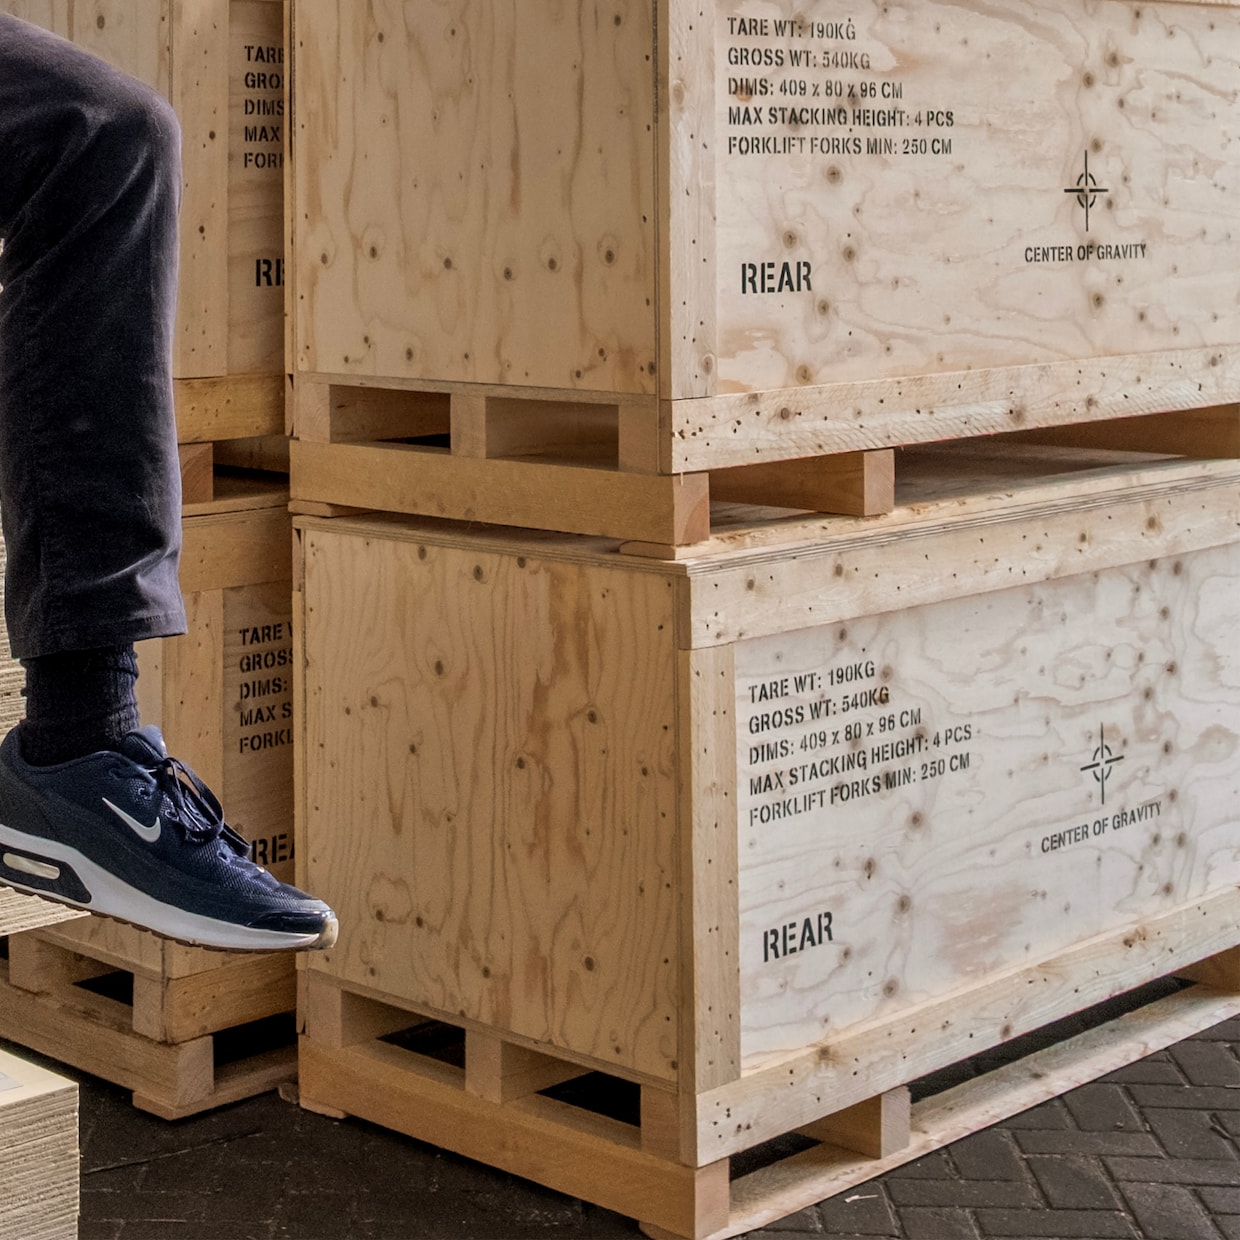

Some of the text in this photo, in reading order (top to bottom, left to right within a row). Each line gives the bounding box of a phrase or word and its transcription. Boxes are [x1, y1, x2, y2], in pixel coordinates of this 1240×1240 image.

[728, 17, 856, 40] TARE WT: 190KG
[728, 47, 870, 70] GROSS WT: 540KG
[245, 72, 284, 89] GRO
[728, 78, 774, 96] DIMS:
[780, 79, 807, 96] 409
[825, 80, 842, 97] 80
[860, 82, 876, 98] 96
[882, 82, 902, 98] CM
[729, 107, 954, 127] MAX STACKING HEIGHT: 4 PCS
[245, 126, 280, 142] MAX
[728, 137, 952, 155] FORKLIFT FORKS MIN: 250 CM
[1025, 244, 1147, 262] CENTER OF GRAVITY
[741, 261, 812, 294] REAR
[239, 623, 282, 645] TARE
[240, 677, 287, 699] DIMS:
[749, 660, 875, 704] TARE WT: 190KG
[240, 705, 276, 726] MAX
[749, 686, 889, 734] GROSS WT: 540KG
[750, 740, 794, 765] DIMS:
[800, 730, 826, 753] 409
[844, 722, 861, 741] 80
[879, 714, 896, 733] 96
[900, 708, 921, 728] CM
[750, 724, 972, 796] MAX STACKING HEIGHT: 4 PCS
[750, 752, 970, 827] FORKLIFT FORKS MIN: 250 CM
[1042, 801, 1161, 853] CENTER OF GRAVITY
[252, 834, 294, 865] RE
[764, 912, 833, 961] REAR
